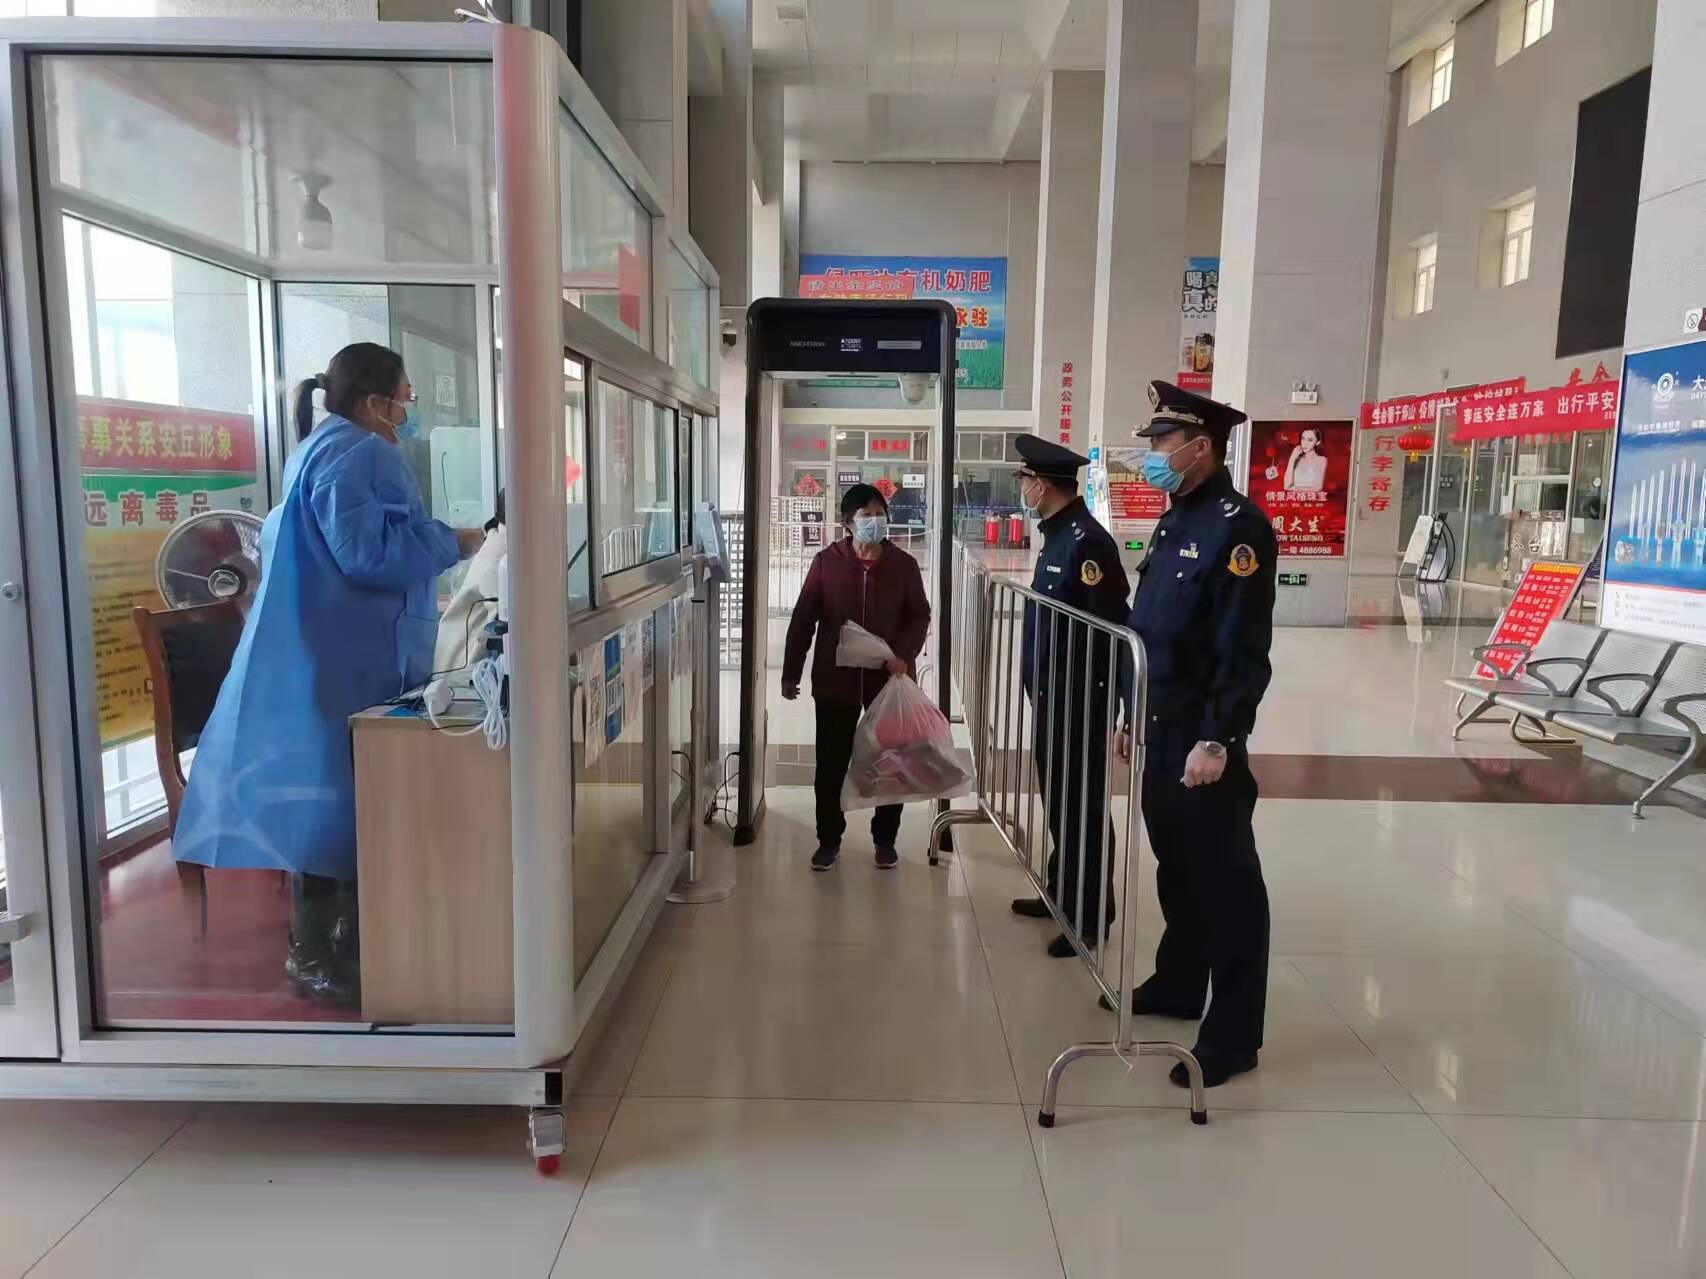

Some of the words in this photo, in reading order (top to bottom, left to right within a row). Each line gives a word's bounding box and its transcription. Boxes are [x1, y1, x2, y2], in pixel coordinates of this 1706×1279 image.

[1059, 360, 1073, 444] 政务公开服务
[1463, 399, 1545, 424] 春运安全连万家
[1558, 389, 1616, 414] 出行平安
[83, 490, 212, 527] 远离毒品
[1265, 490, 1327, 501] 情景风格珠宝
[1271, 515, 1320, 533] 周大生
